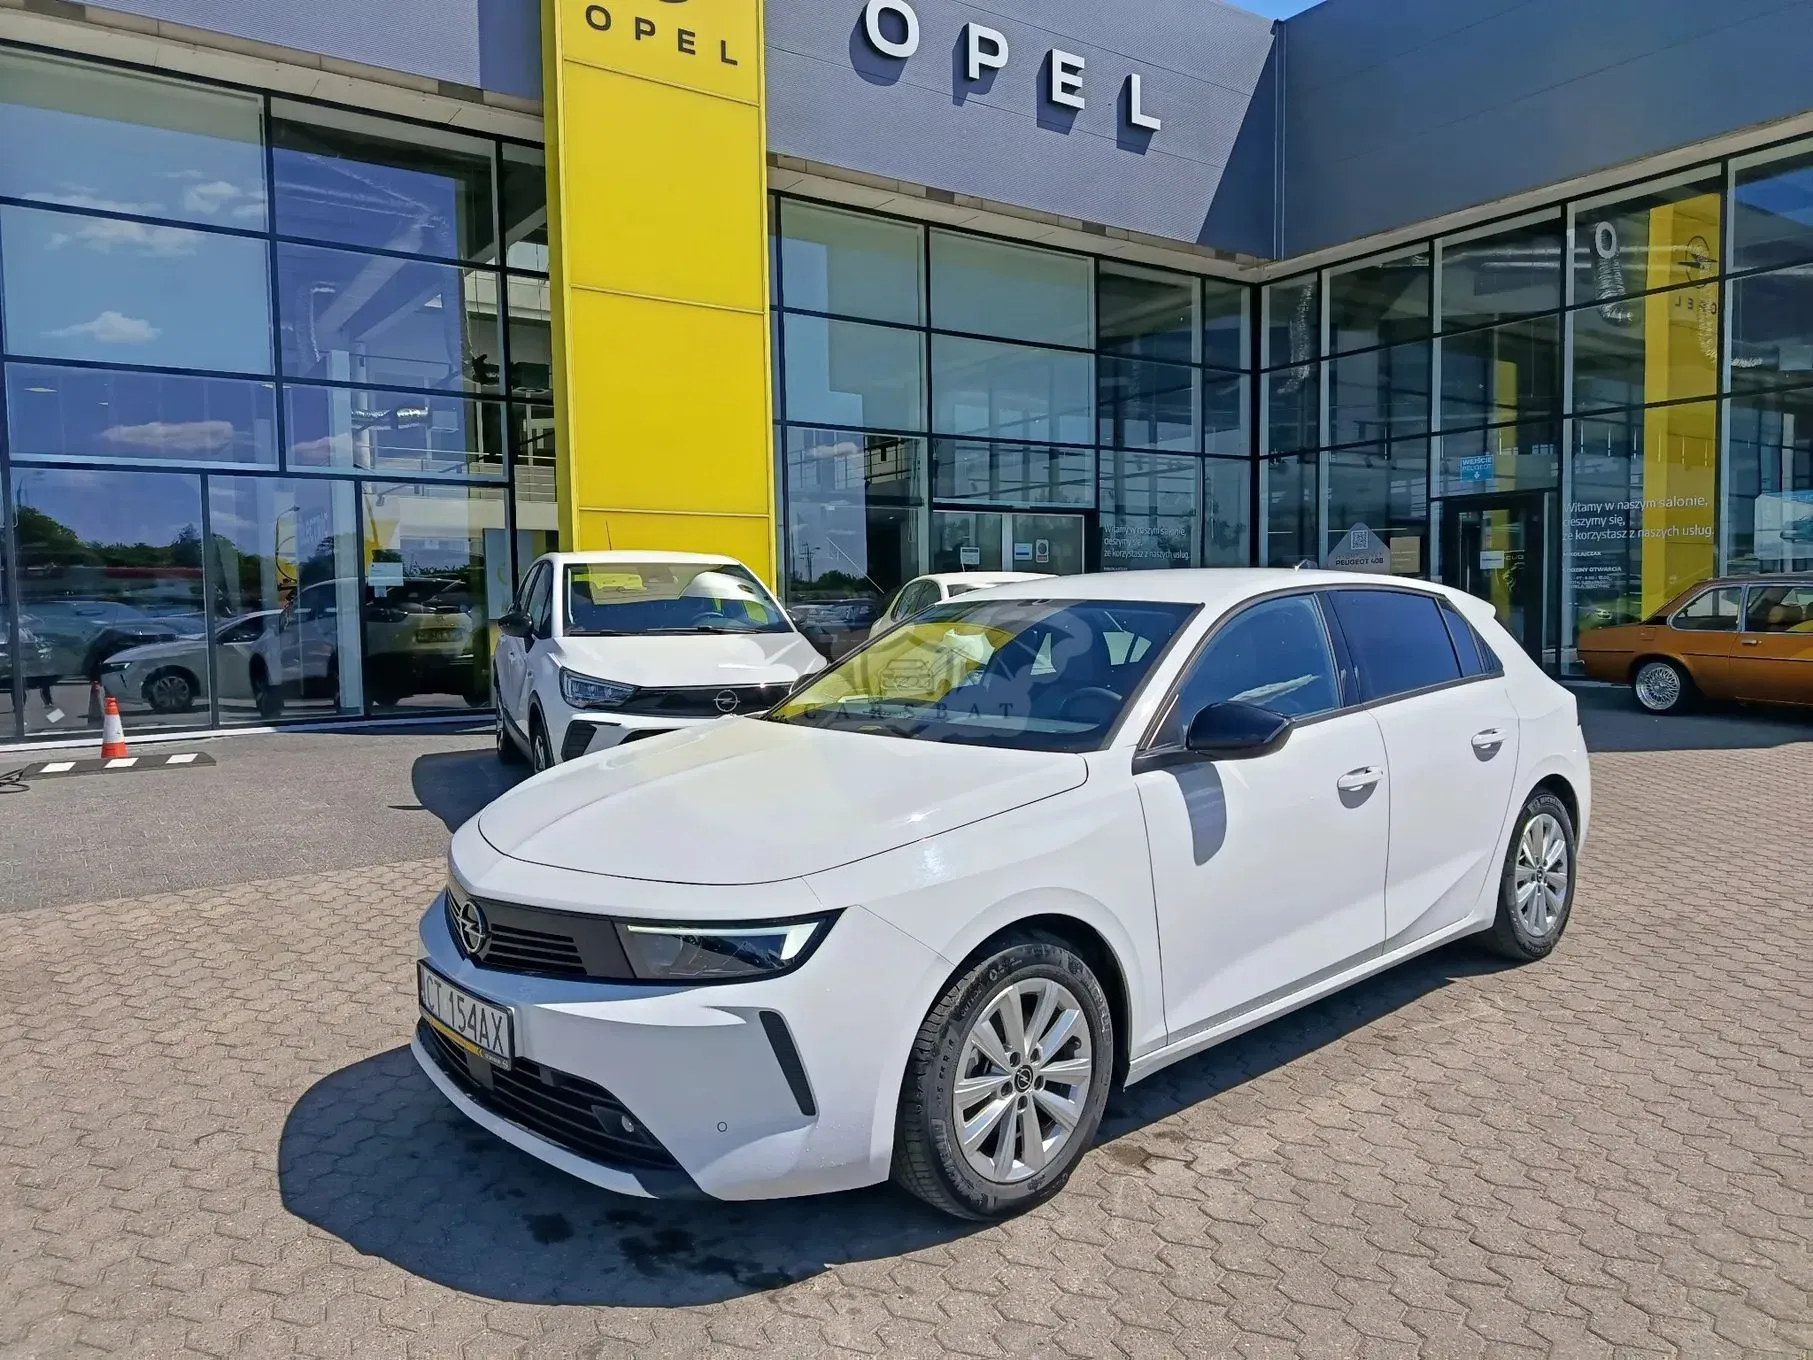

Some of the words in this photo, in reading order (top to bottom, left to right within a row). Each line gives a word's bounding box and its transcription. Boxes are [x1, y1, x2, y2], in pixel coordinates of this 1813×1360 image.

[585, 5, 738, 66] OPEL
[866, 0, 1161, 131] OPEL
[1564, 502, 1603, 514] Witamy
[1605, 503, 1616, 511] w
[1617, 500, 1656, 514] naszym
[1659, 496, 1709, 508] salonie,
[1610, 514, 1626, 526] się,
[1575, 528, 1627, 541] korzystasz
[1638, 526, 1680, 540] naszych
[1682, 524, 1715, 538] usług.
[1336, 558, 1369, 566] PEUGEOT
[426, 975, 442, 1017] CT
[449, 991, 503, 1055] 154AX
